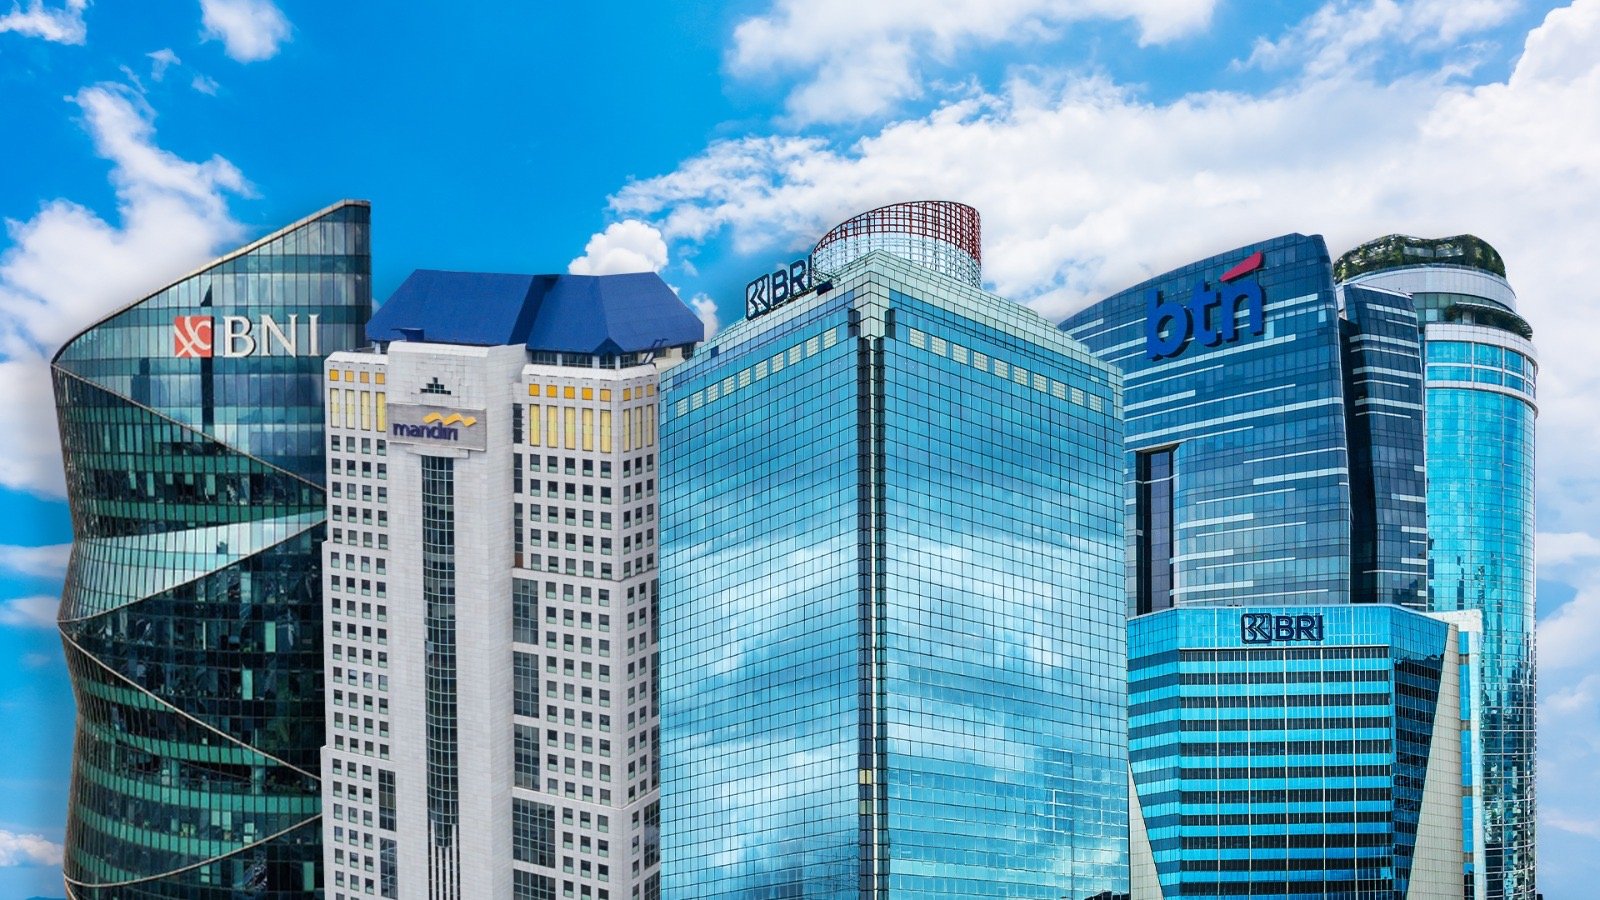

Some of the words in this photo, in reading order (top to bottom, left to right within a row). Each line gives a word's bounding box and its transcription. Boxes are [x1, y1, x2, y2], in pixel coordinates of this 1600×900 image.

[771, 255, 813, 306] BRI
[223, 313, 320, 358] BNI
[1146, 277, 1265, 361] btn
[393, 421, 458, 441] mandiri
[1275, 615, 1323, 642] BRI
